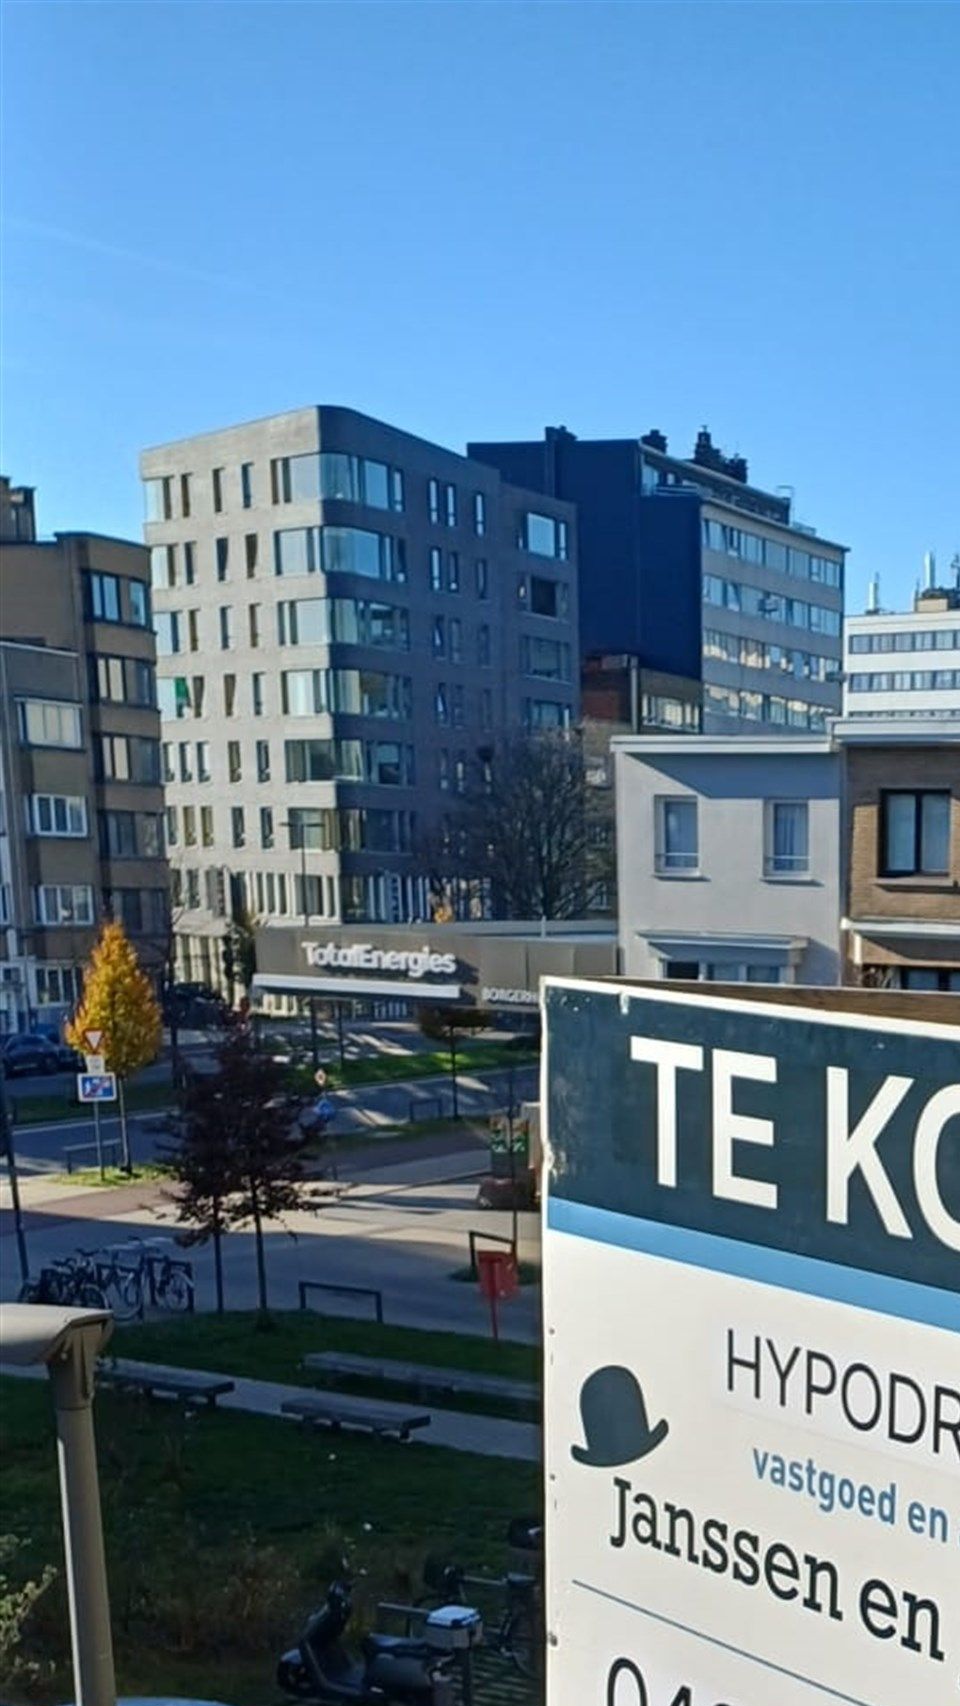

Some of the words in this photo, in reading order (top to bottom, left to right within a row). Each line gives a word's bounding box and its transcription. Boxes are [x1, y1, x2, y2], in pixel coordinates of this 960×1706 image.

[302, 942, 457, 976] TotalEnergies
[630, 1036, 778, 1209] TE
[752, 1448, 897, 1526] vastgoed
[907, 1500, 949, 1543] en
[609, 1477, 843, 1621] Janssen
[859, 1578, 944, 1662] en
